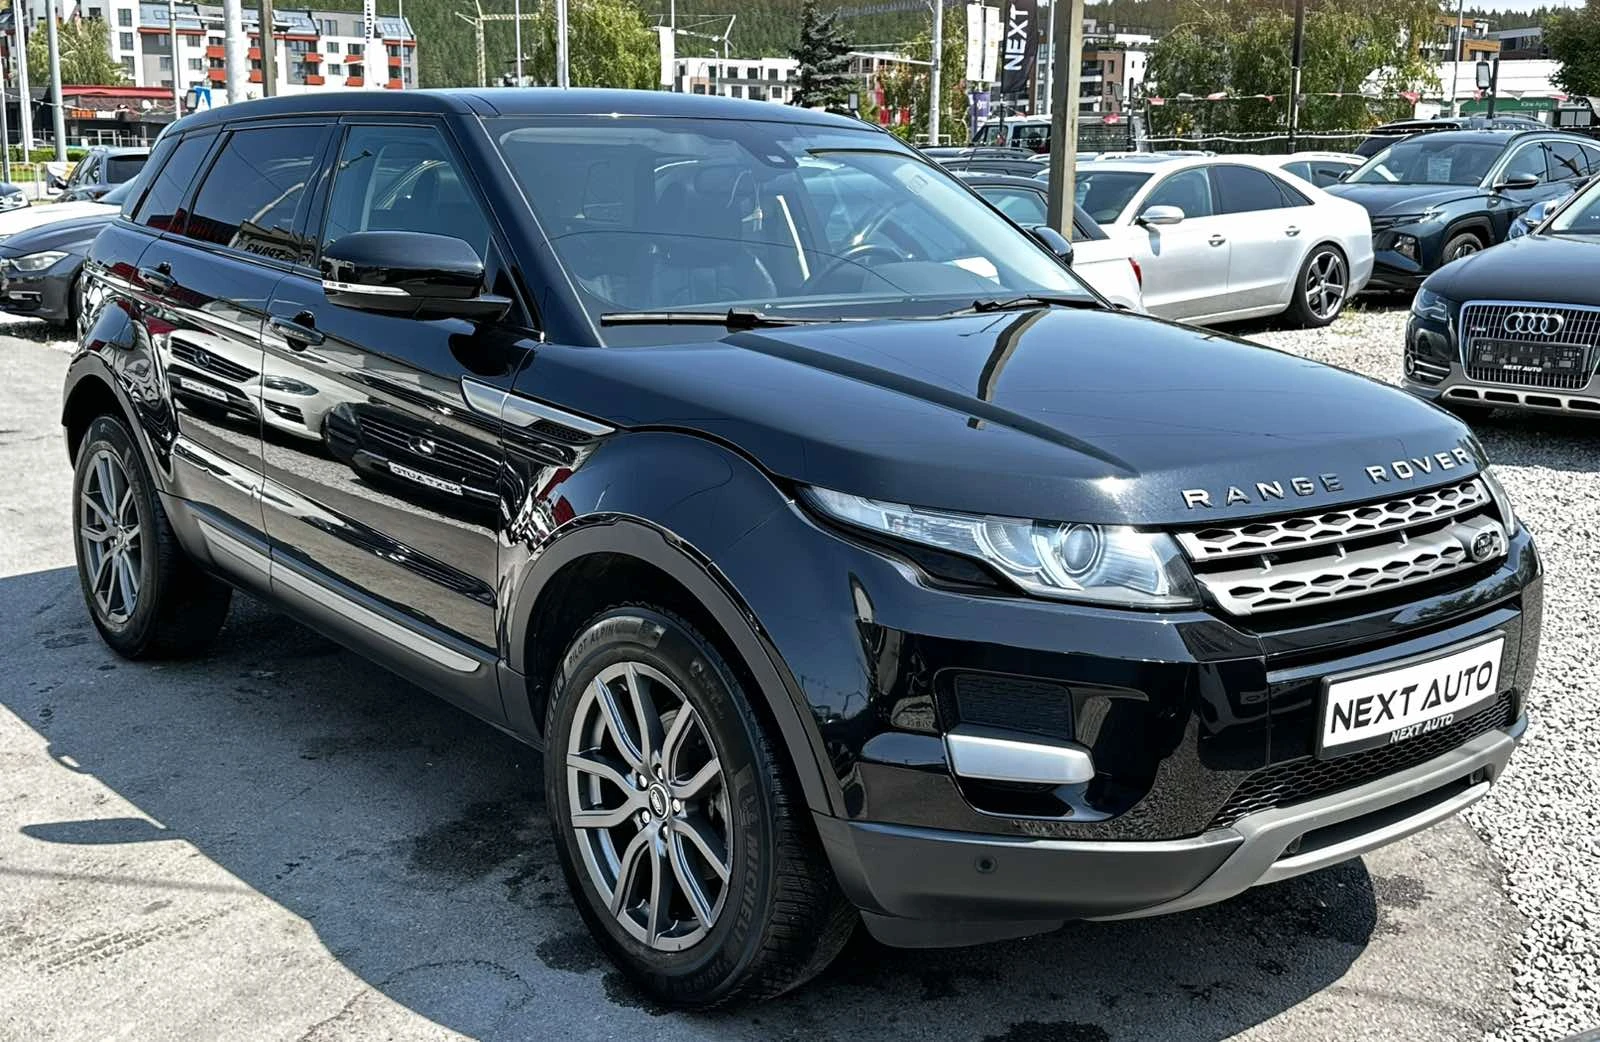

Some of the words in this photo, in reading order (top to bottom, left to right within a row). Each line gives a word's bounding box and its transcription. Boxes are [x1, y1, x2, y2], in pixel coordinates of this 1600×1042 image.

[1003, 3, 1028, 71] NEXT
[1503, 364, 1522, 372] NEXT
[1180, 473, 1344, 509] RANGE
[1365, 447, 1471, 484] ROVER
[568, 638, 588, 665] PILOT
[1331, 683, 1419, 733] NEXT
[1420, 660, 1492, 712] AUTO
[1390, 723, 1423, 744] NEXT
[1423, 714, 1454, 732] AUTO
[733, 832, 759, 944] MICHELI
